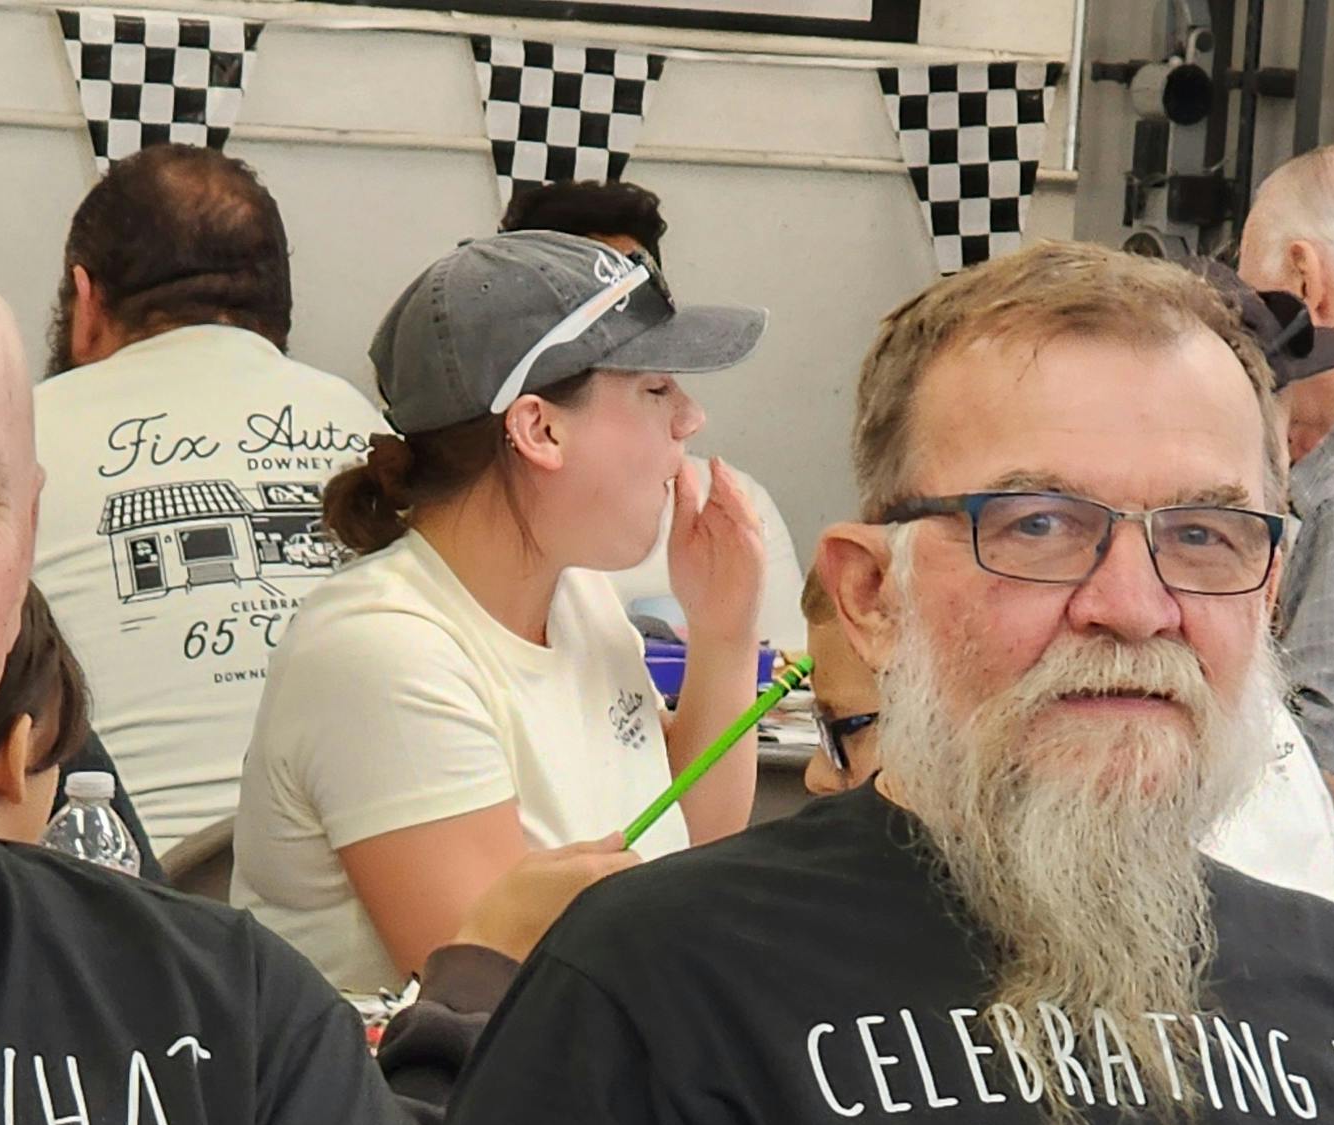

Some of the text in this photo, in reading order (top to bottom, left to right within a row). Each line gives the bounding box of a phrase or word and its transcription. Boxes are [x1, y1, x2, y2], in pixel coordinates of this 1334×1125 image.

[98, 404, 371, 477] Fix Auto
[247, 457, 335, 471] DOWNEY
[230, 597, 304, 614] CELEBRA
[183, 617, 238, 660] 65
[214, 668, 267, 684] DOWNE
[806, 1001, 1317, 1120] CELEBRATING
